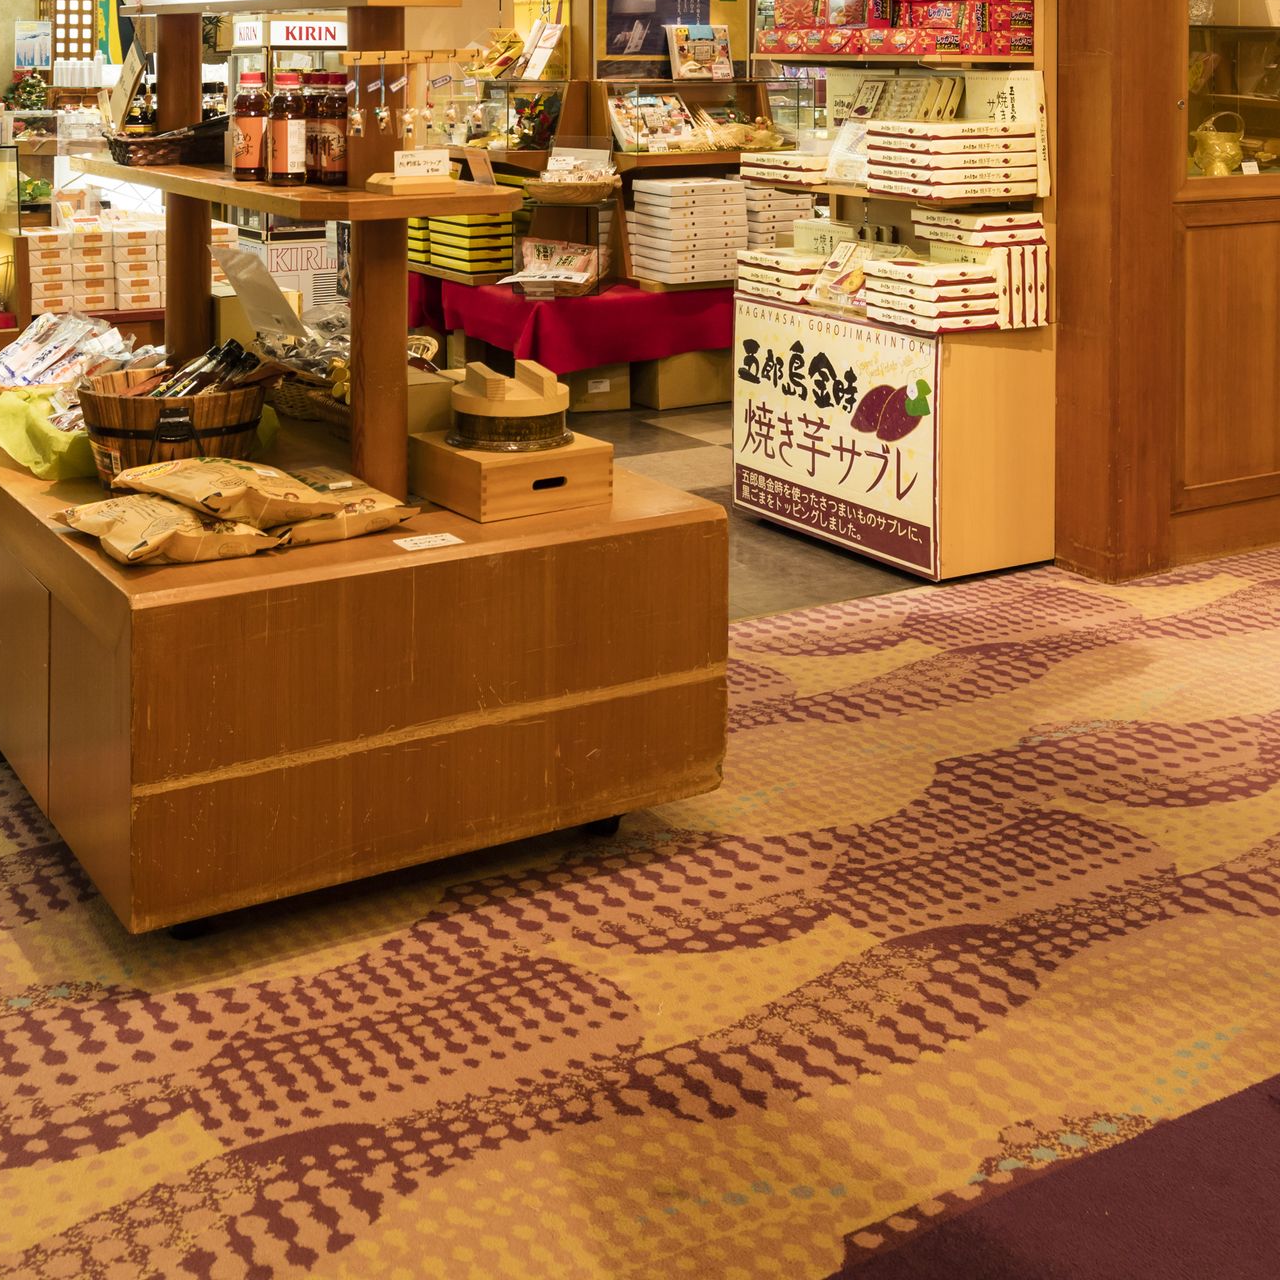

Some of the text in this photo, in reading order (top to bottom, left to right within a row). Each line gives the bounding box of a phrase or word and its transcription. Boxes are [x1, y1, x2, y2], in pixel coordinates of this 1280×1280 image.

[238, 26, 257, 41] KIRIN
[285, 26, 336, 41] KIRIN
[739, 305, 932, 356] KAGAYASAI GOROJIMAKINTOKI
[737, 338, 859, 414] 五郎島金時
[740, 398, 918, 501] 焼き芋サブレ
[742, 469, 923, 544] 五郎島金時を使ったさつまいものサブレに、
[742, 485, 861, 541] 黒ごまをトッピングしました。
